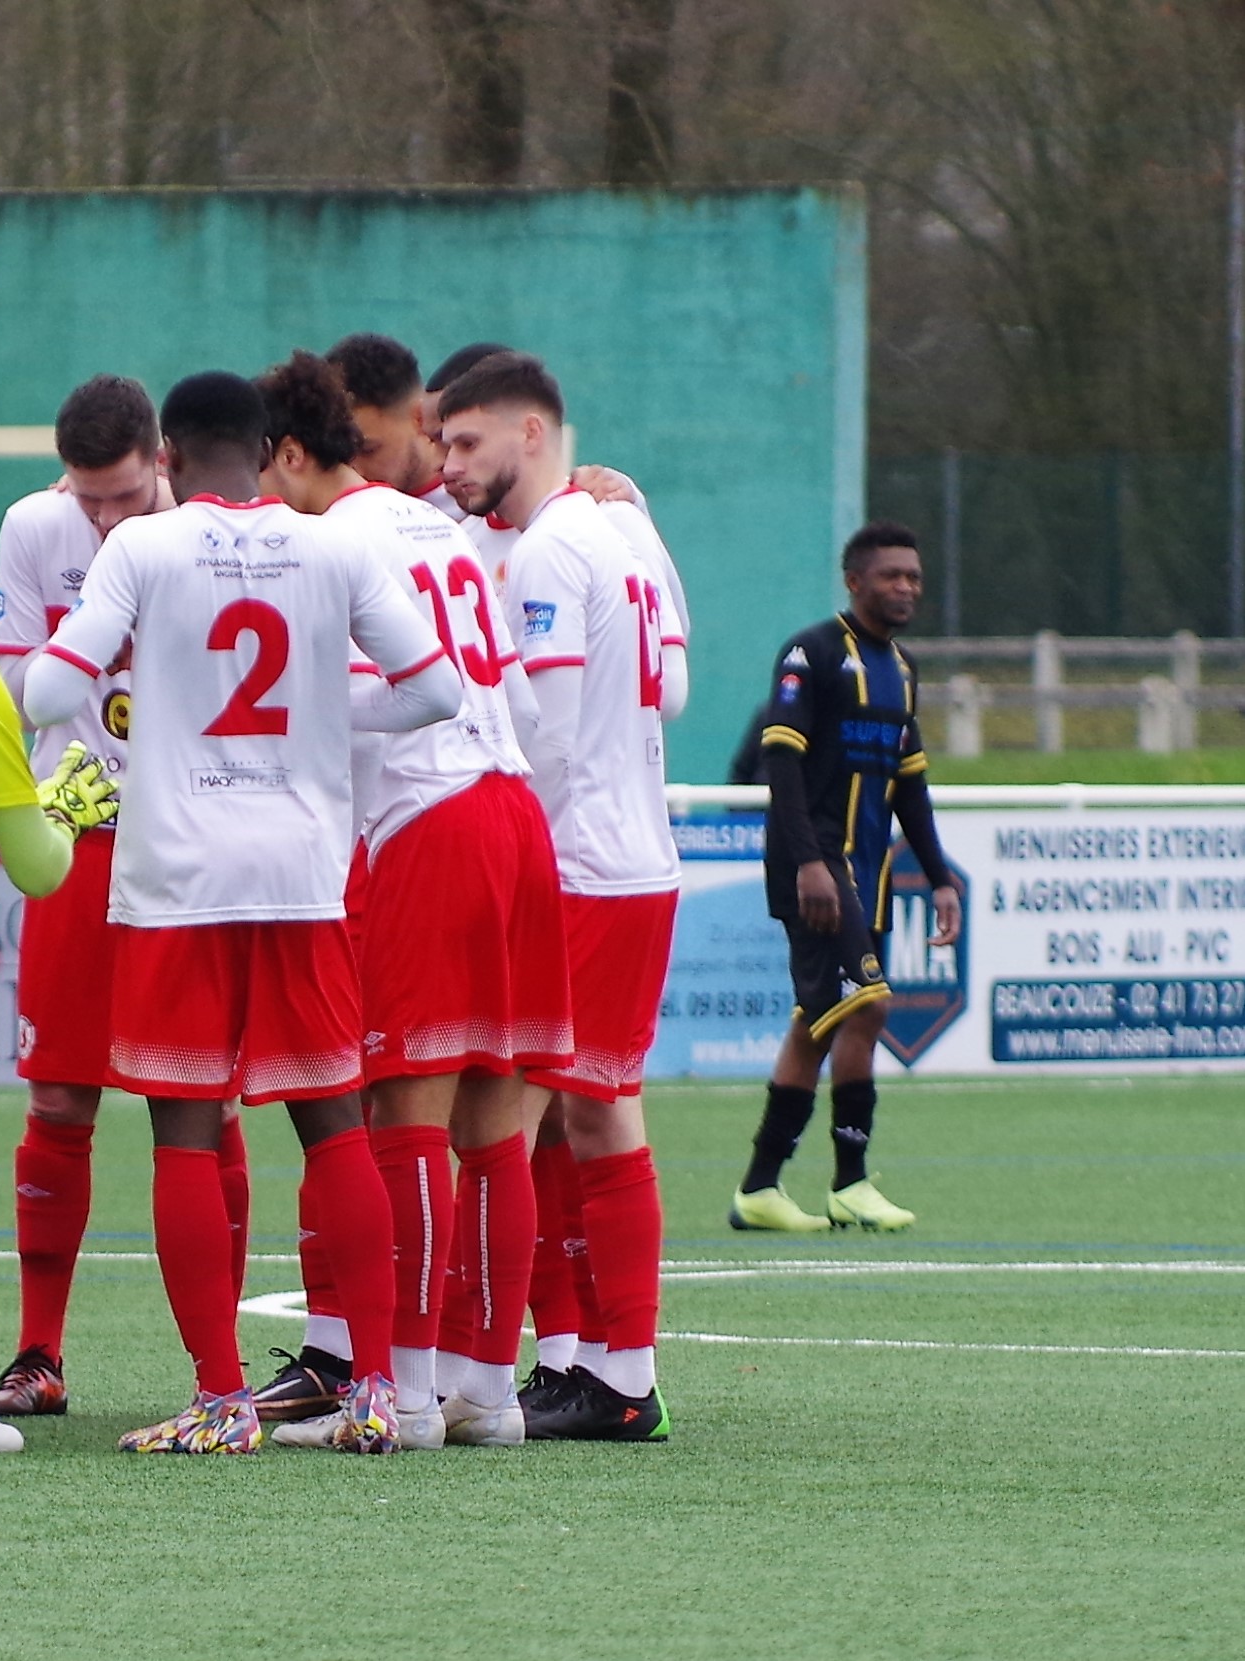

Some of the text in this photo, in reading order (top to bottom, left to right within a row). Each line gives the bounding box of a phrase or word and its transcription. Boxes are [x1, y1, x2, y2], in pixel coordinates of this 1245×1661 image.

[409, 556, 502, 688] 13
[201, 597, 290, 736] 2
[994, 825, 1245, 860] MENUISERIES EXTERIEU
[993, 876, 1245, 913] & AGENCEMENT INTERI
[1047, 929, 1102, 964] BOIS
[1124, 928, 1164, 963] ALU
[1185, 928, 1230, 962] PVC
